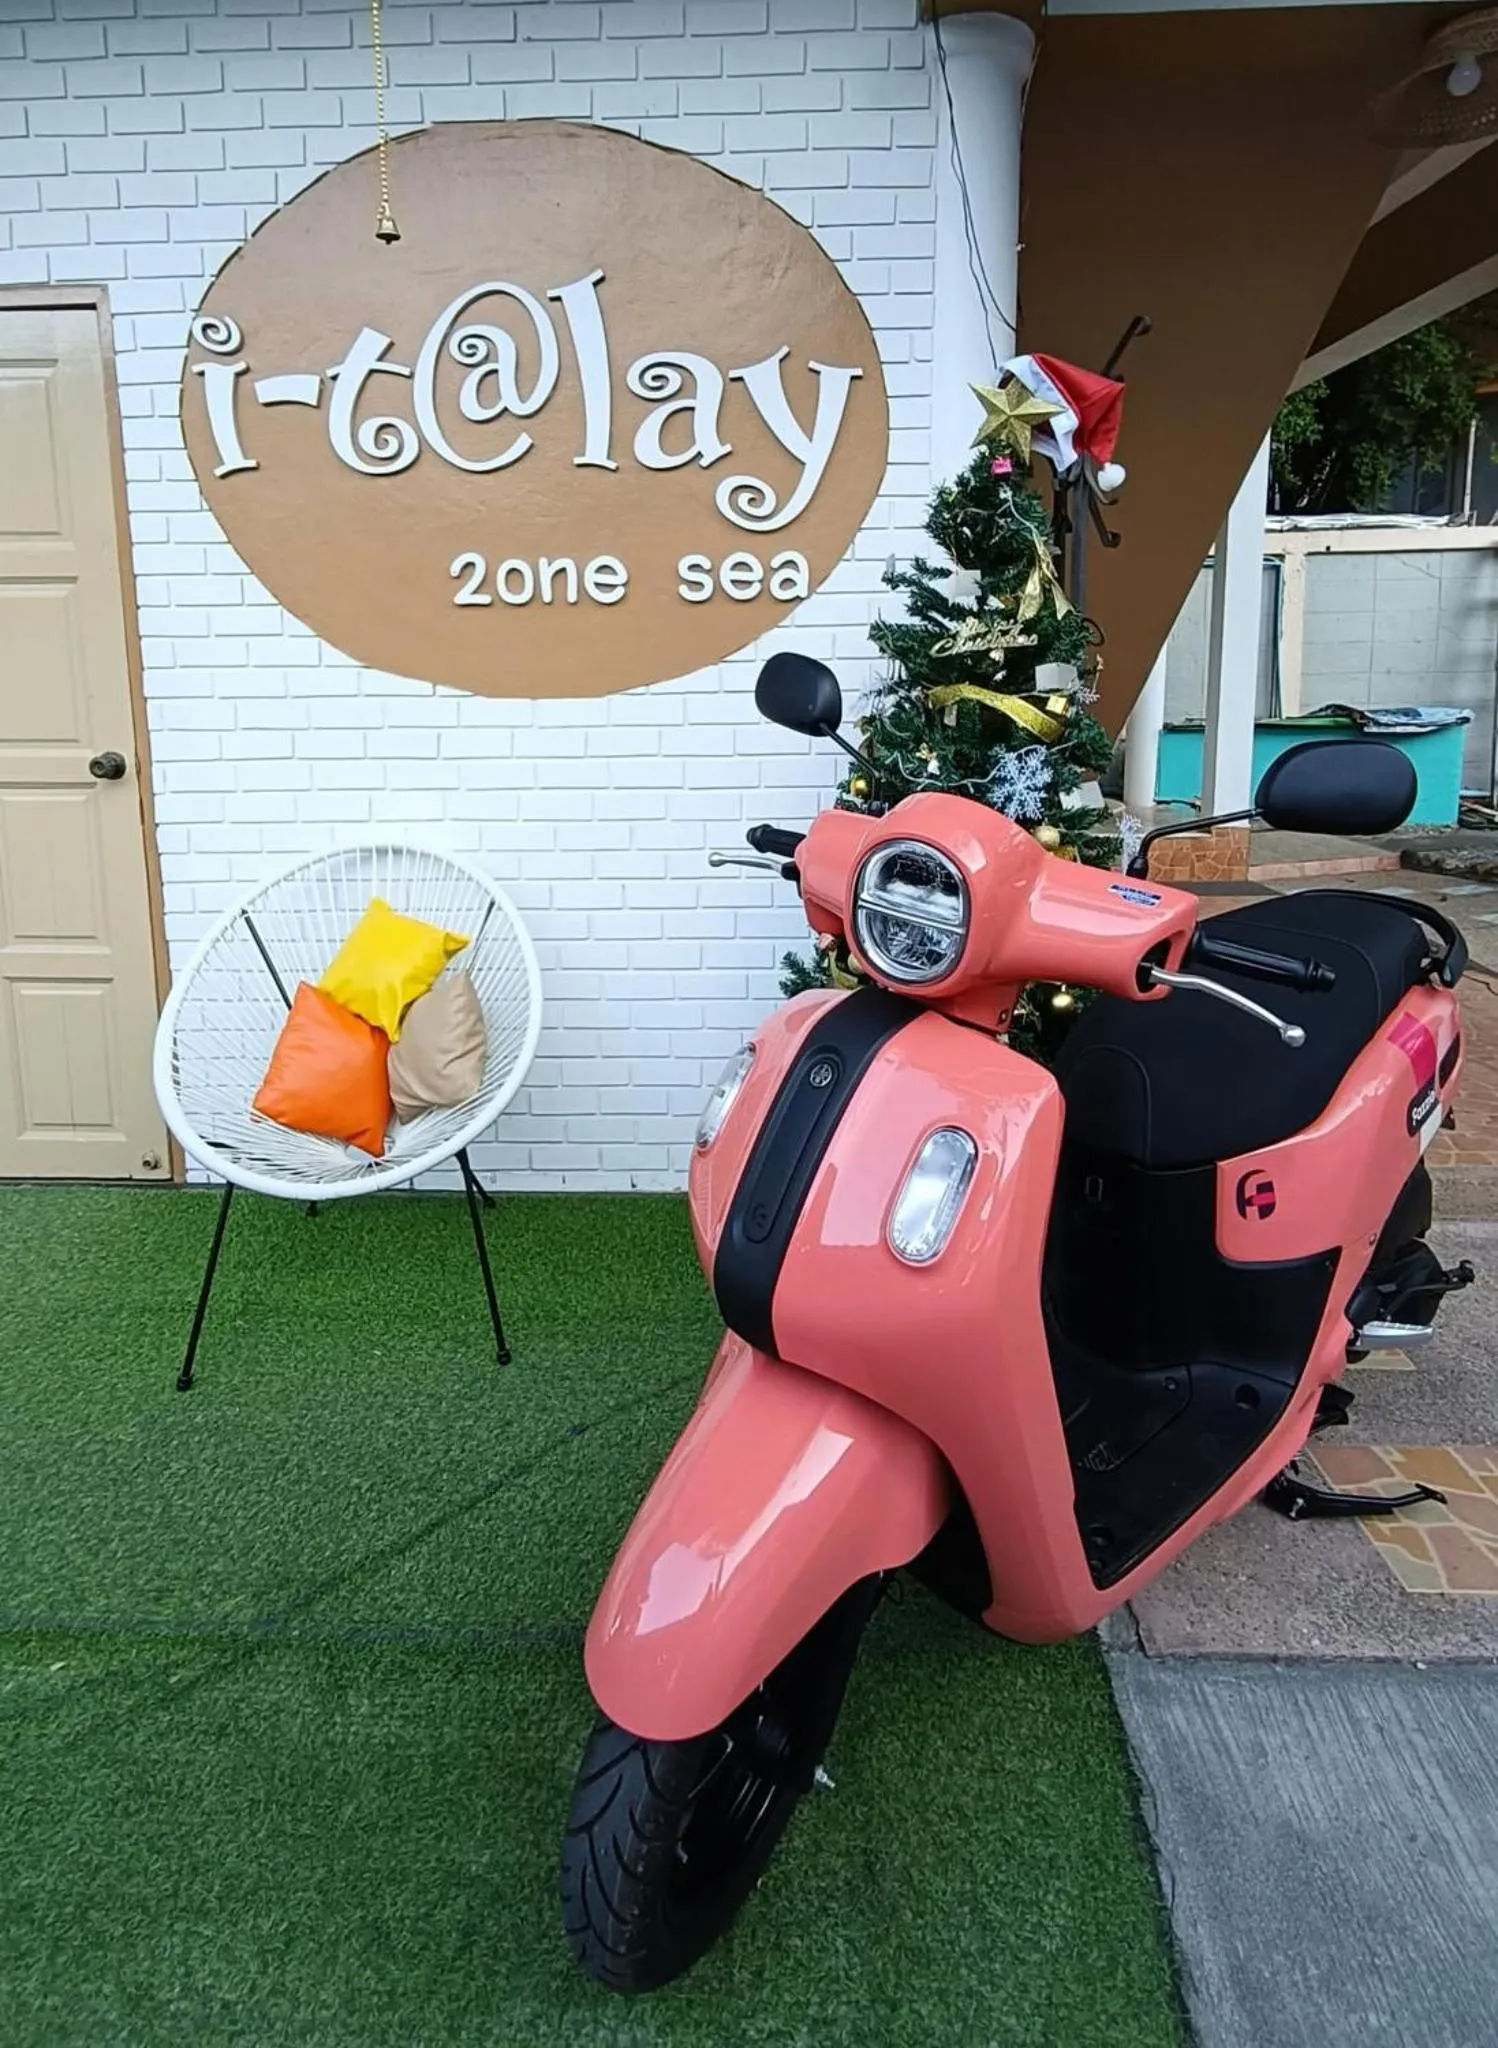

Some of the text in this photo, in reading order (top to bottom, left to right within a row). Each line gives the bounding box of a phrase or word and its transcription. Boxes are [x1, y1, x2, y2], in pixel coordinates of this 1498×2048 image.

[190, 268, 864, 532] i-t@lay
[448, 549, 812, 606] 2one sea
